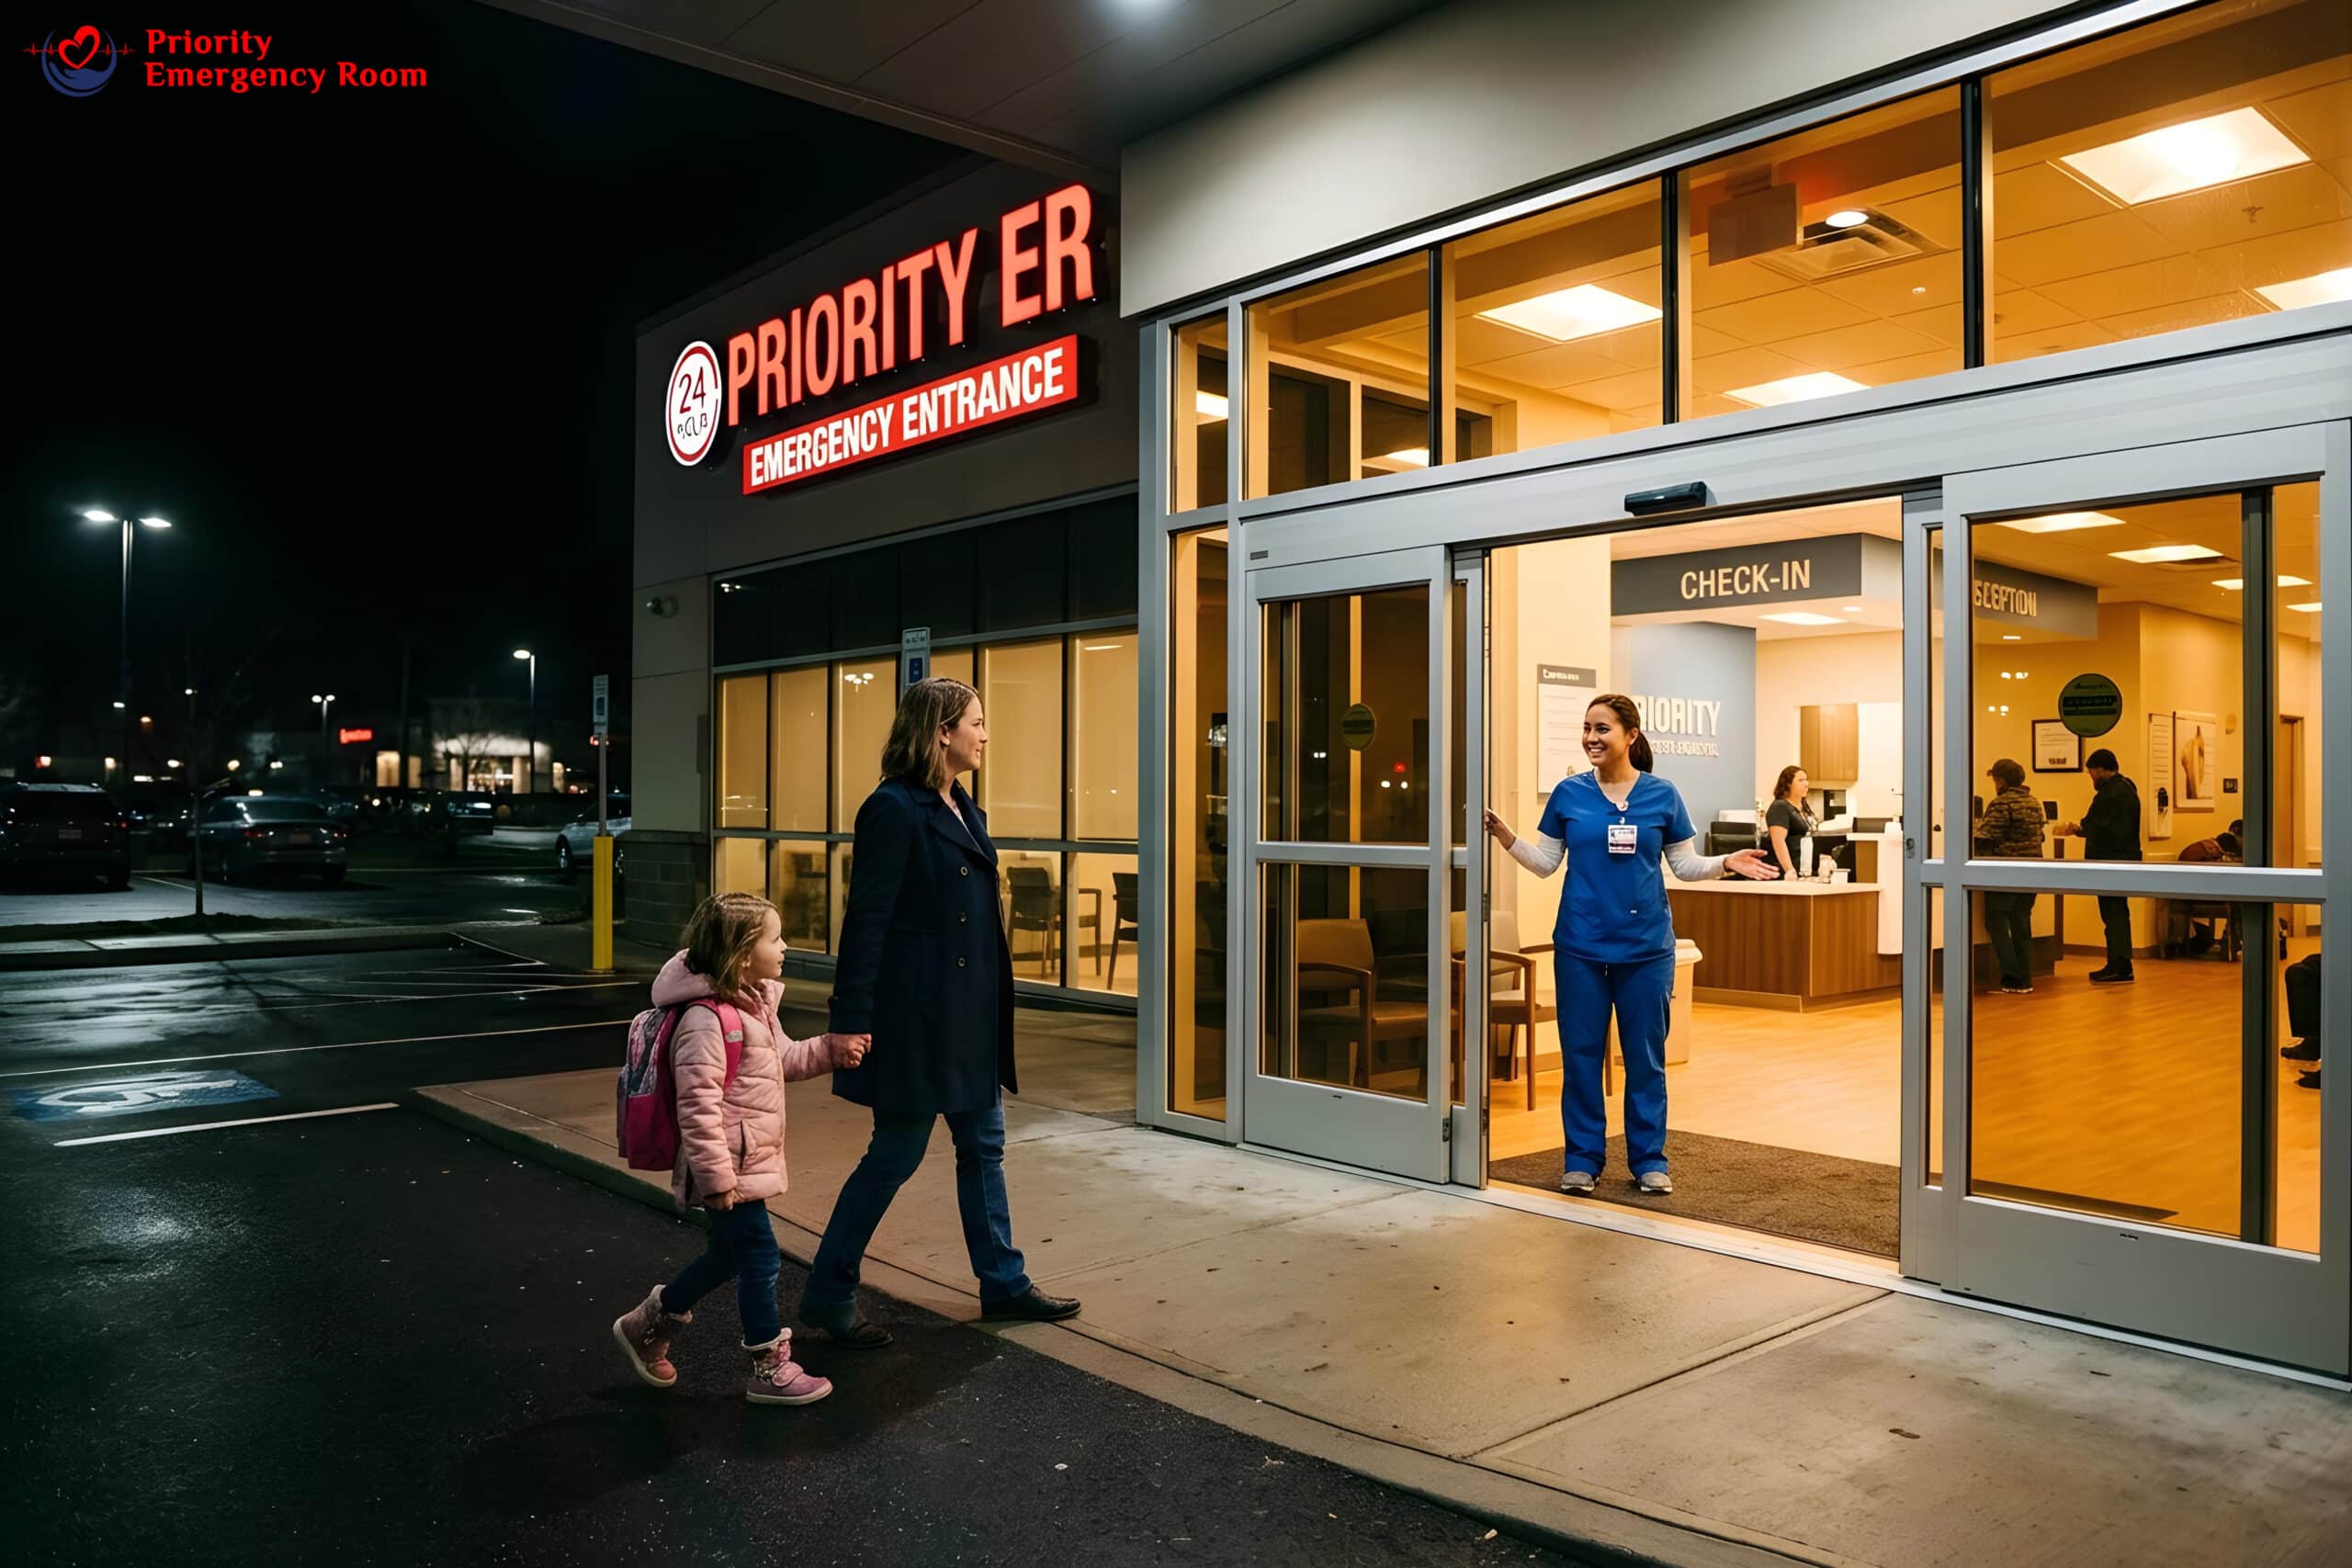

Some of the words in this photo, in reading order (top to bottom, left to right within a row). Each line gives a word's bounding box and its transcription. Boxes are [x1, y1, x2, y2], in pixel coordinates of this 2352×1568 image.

[728, 228, 978, 426] PRIORITY
[1001, 184, 1095, 328] ER
[679, 366, 707, 414] 24
[751, 404, 895, 487] EMERGENCY
[902, 347, 1064, 441] ENTRANCE
[1680, 559, 1811, 600] CHECK-IN
[1633, 695, 1721, 736] RIORITY
